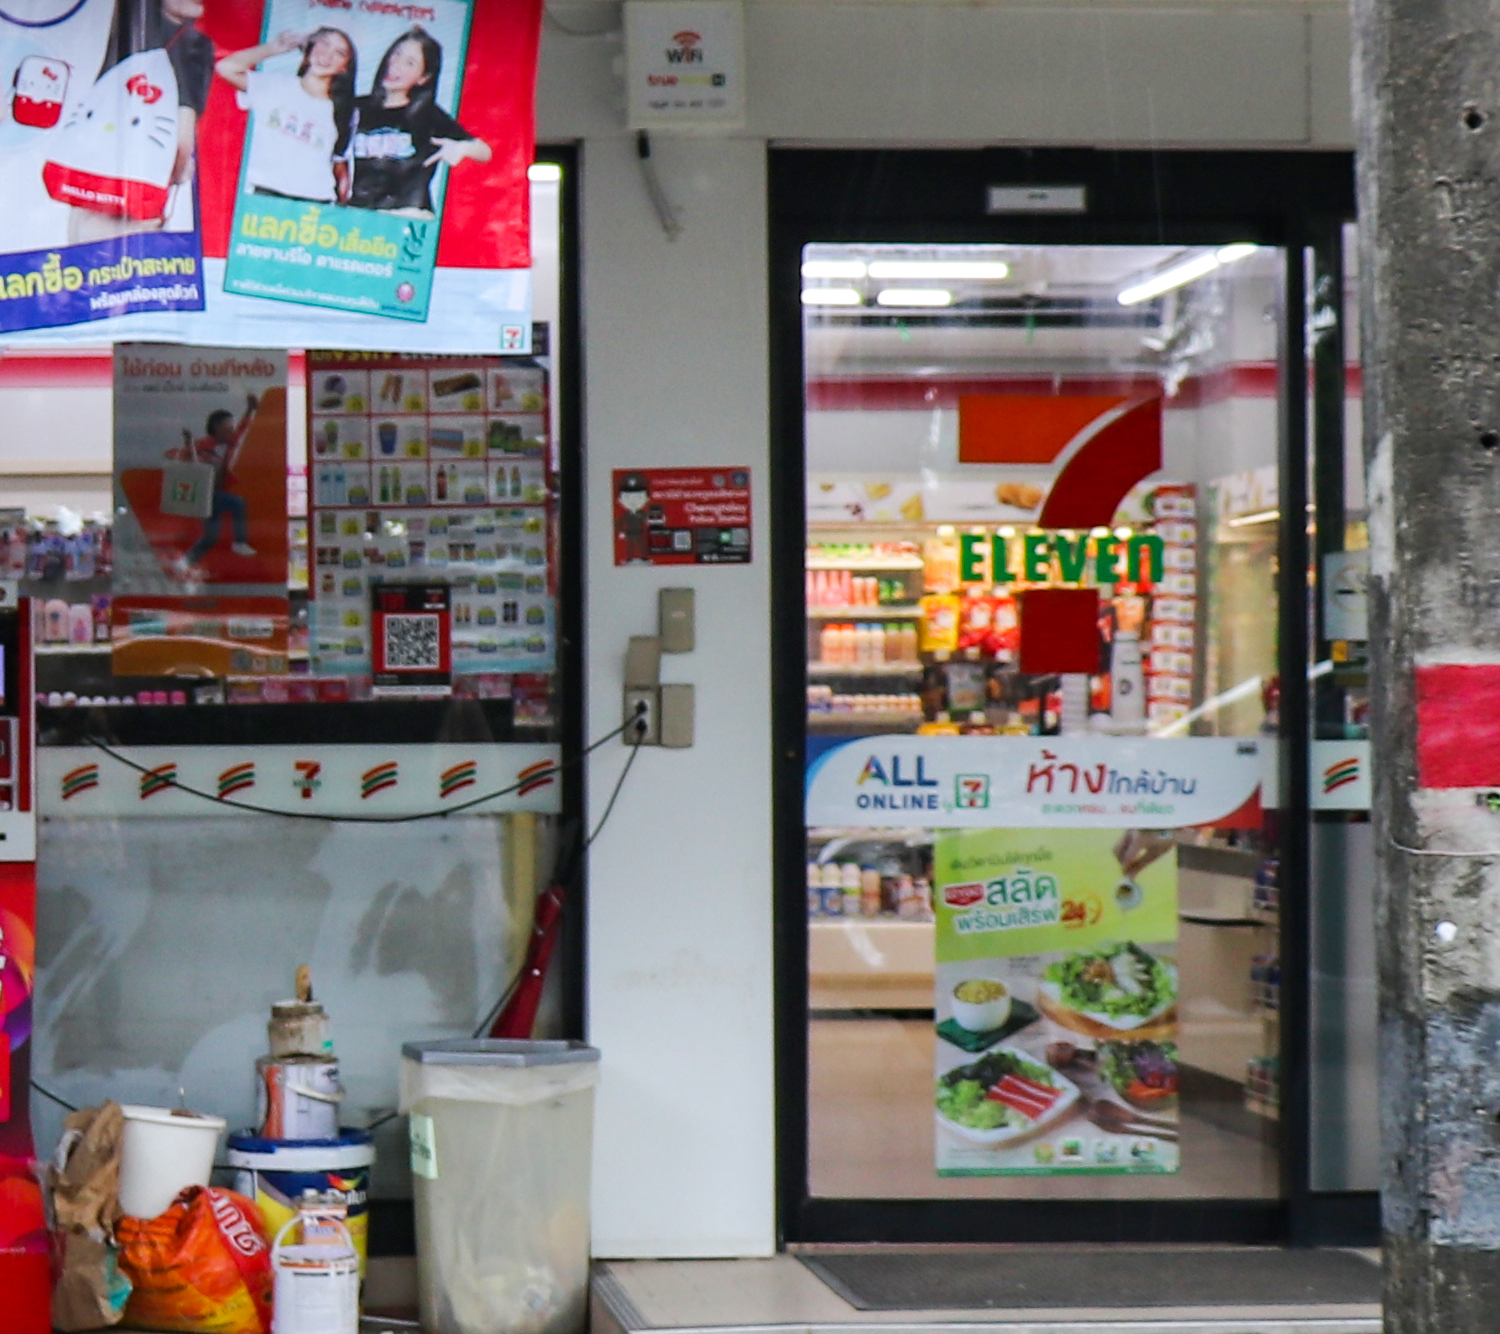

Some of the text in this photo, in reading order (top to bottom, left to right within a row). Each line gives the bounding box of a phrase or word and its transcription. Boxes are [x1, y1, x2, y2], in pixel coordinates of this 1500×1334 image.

[240, 205, 339, 248] แลกซื้อ
[87, 255, 197, 286] กระเป๋าสะพาย
[858, 754, 939, 787] ALL
[856, 793, 939, 810] ONLINE
